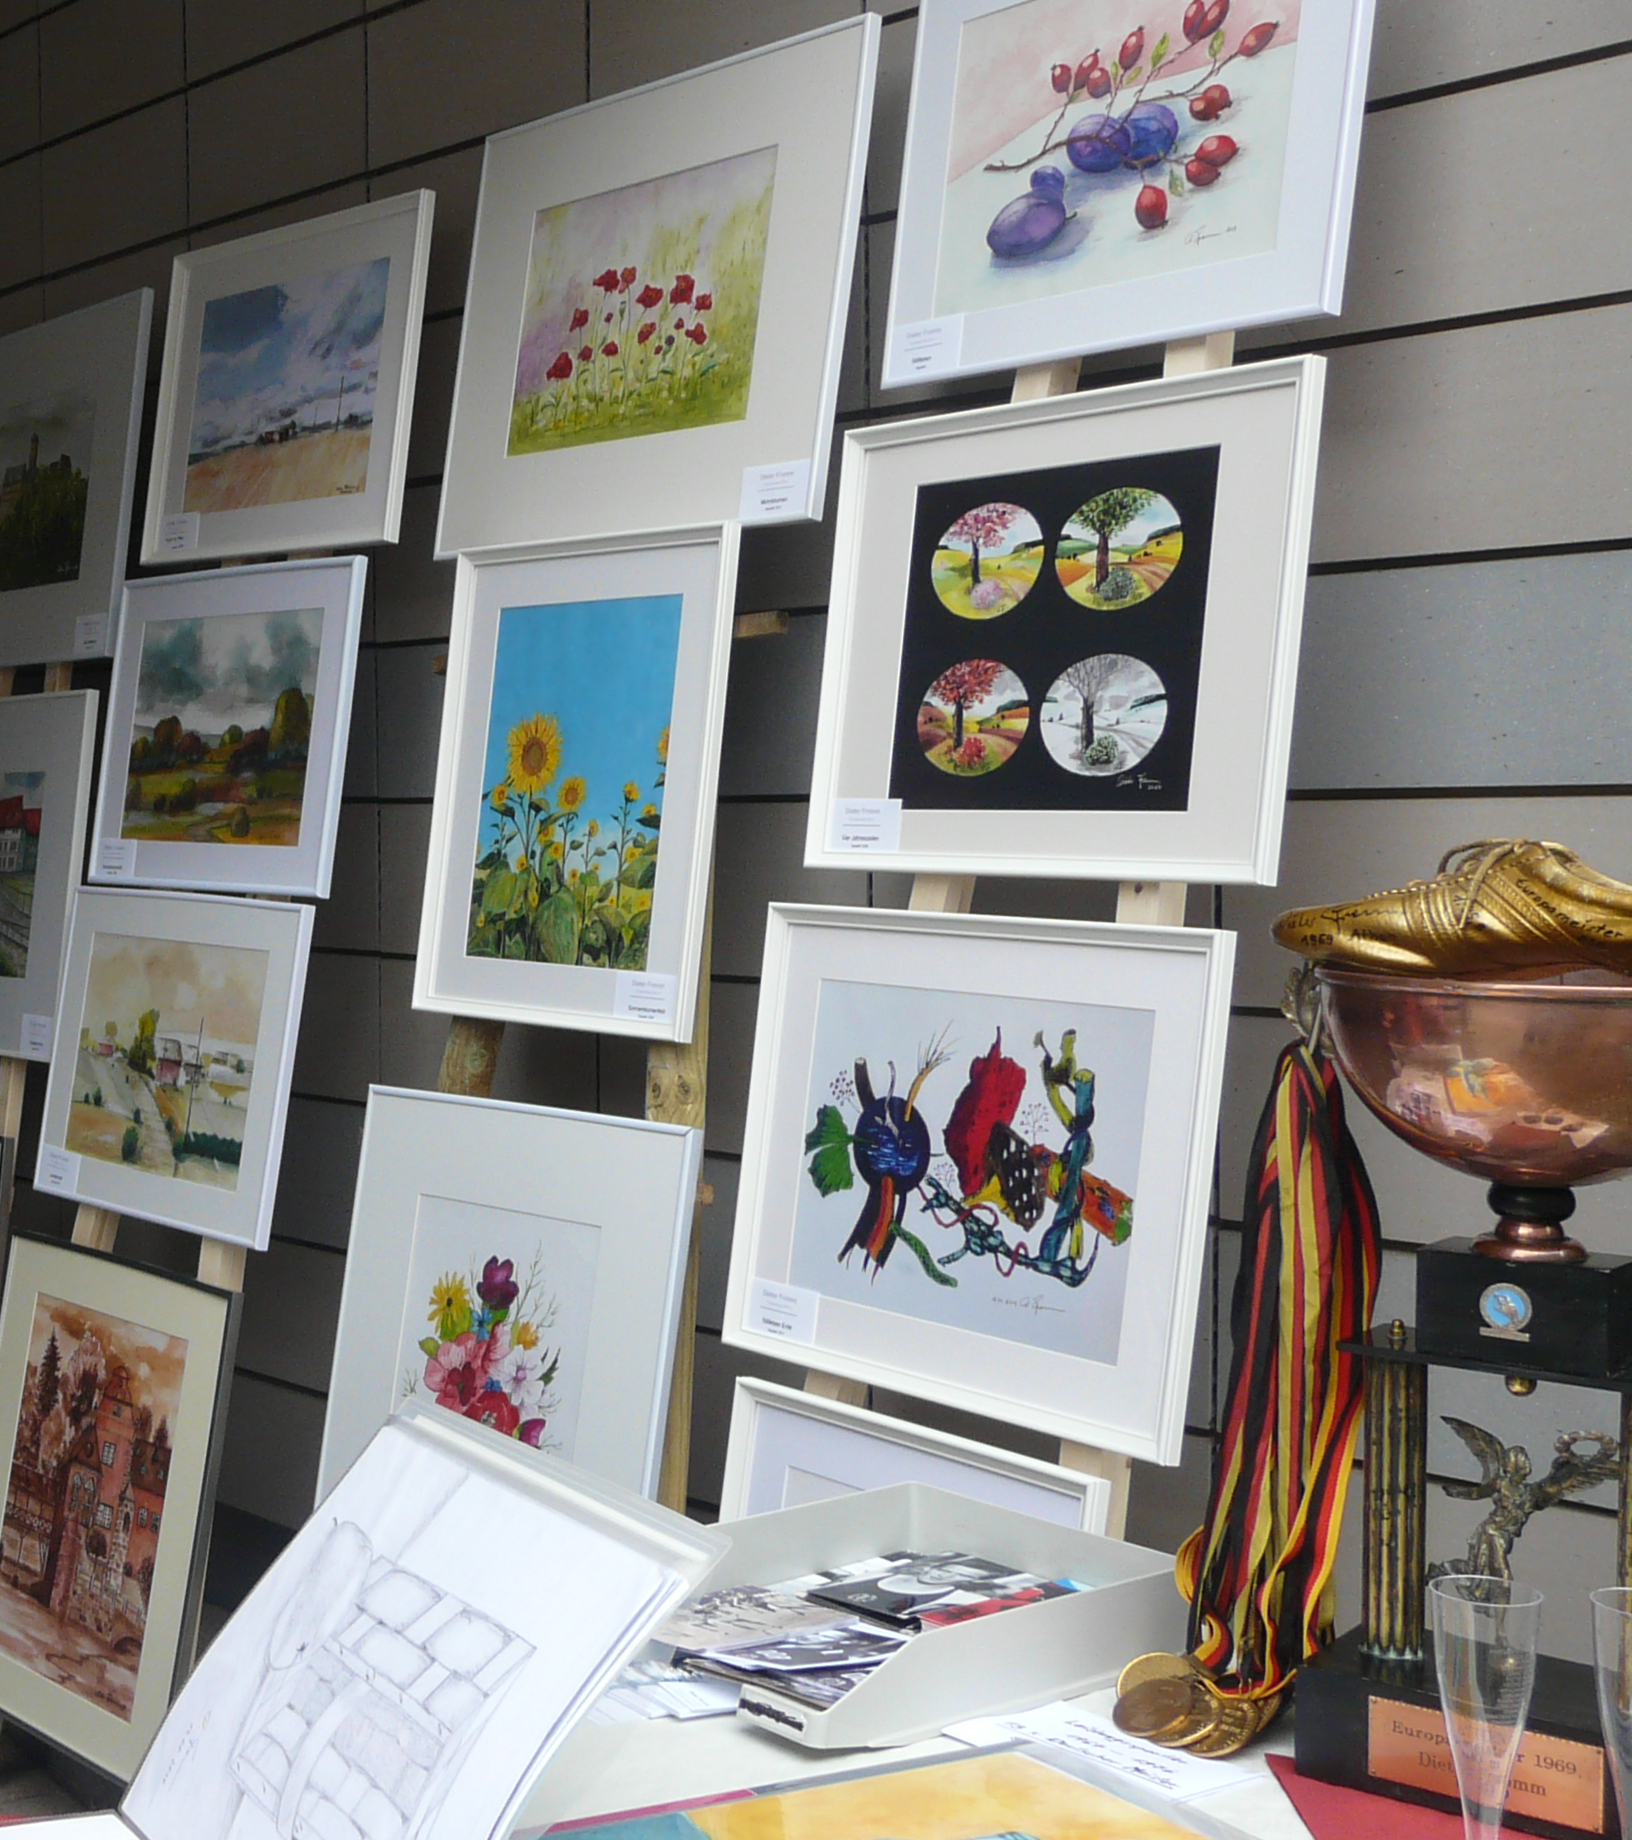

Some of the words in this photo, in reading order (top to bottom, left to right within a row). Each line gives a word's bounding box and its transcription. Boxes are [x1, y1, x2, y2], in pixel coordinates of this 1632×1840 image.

[1515, 878, 1625, 939] Europameister
[1300, 933, 1334, 947] 1969
[1532, 1753, 1583, 1779] 1969.
